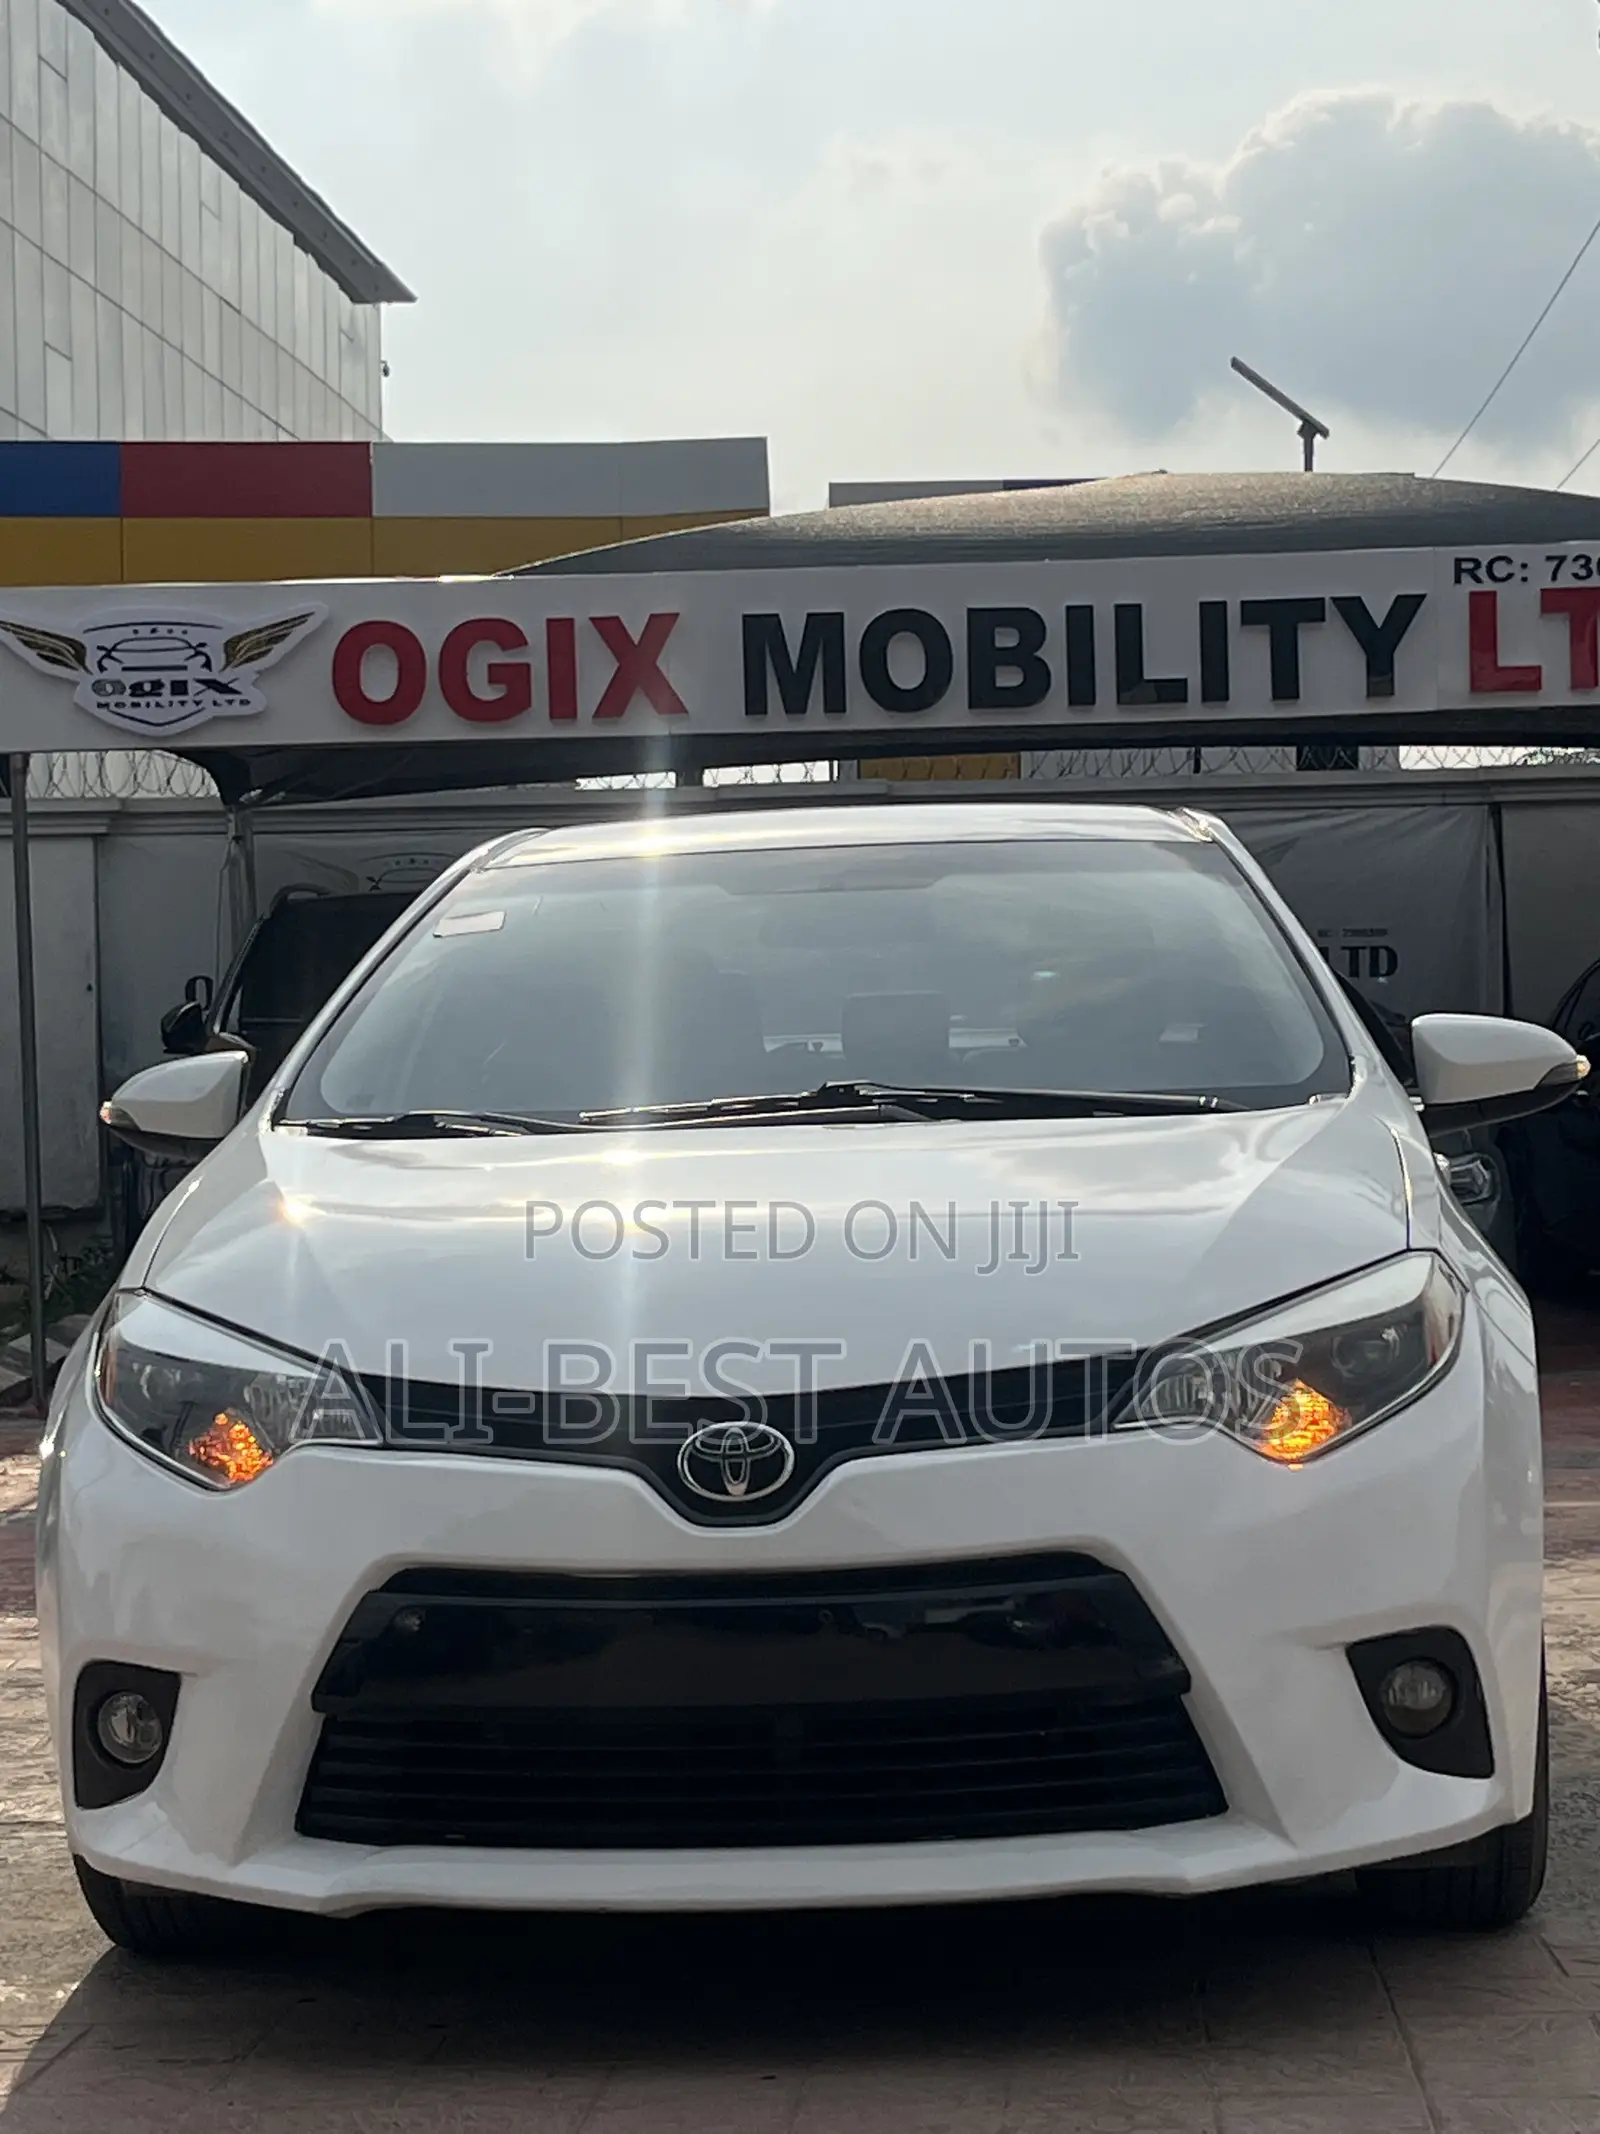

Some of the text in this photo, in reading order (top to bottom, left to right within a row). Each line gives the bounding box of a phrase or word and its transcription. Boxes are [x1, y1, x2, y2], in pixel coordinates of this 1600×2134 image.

[1453, 553, 1600, 585] RC: 73
[331, 612, 689, 726] OGIX
[742, 593, 1427, 718] MOBILITY
[96, 698, 252, 710] MOBILITY LTD
